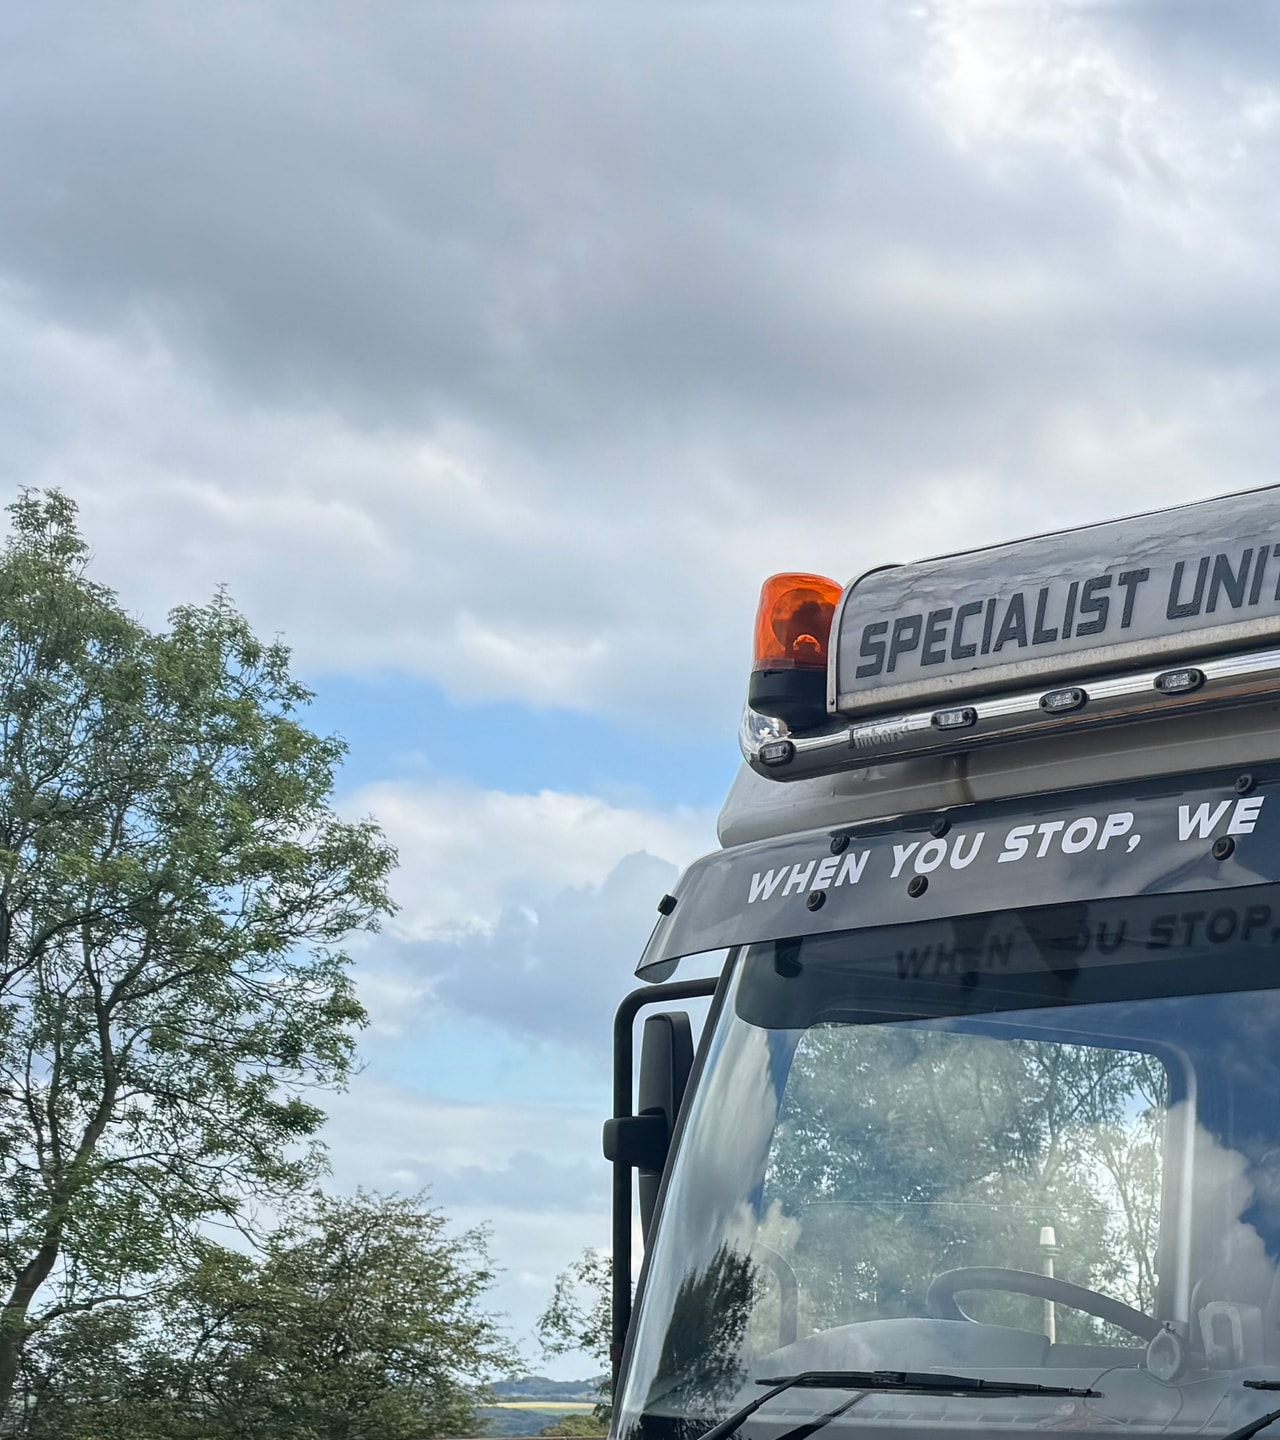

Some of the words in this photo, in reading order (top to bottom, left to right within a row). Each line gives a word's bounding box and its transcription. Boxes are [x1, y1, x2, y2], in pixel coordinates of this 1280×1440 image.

[855, 567, 1150, 679] SPECIALIST
[747, 850, 871, 904] WHEN
[890, 831, 986, 879] YOU
[998, 811, 1142, 864] STOP,
[1178, 795, 1265, 842] WE
